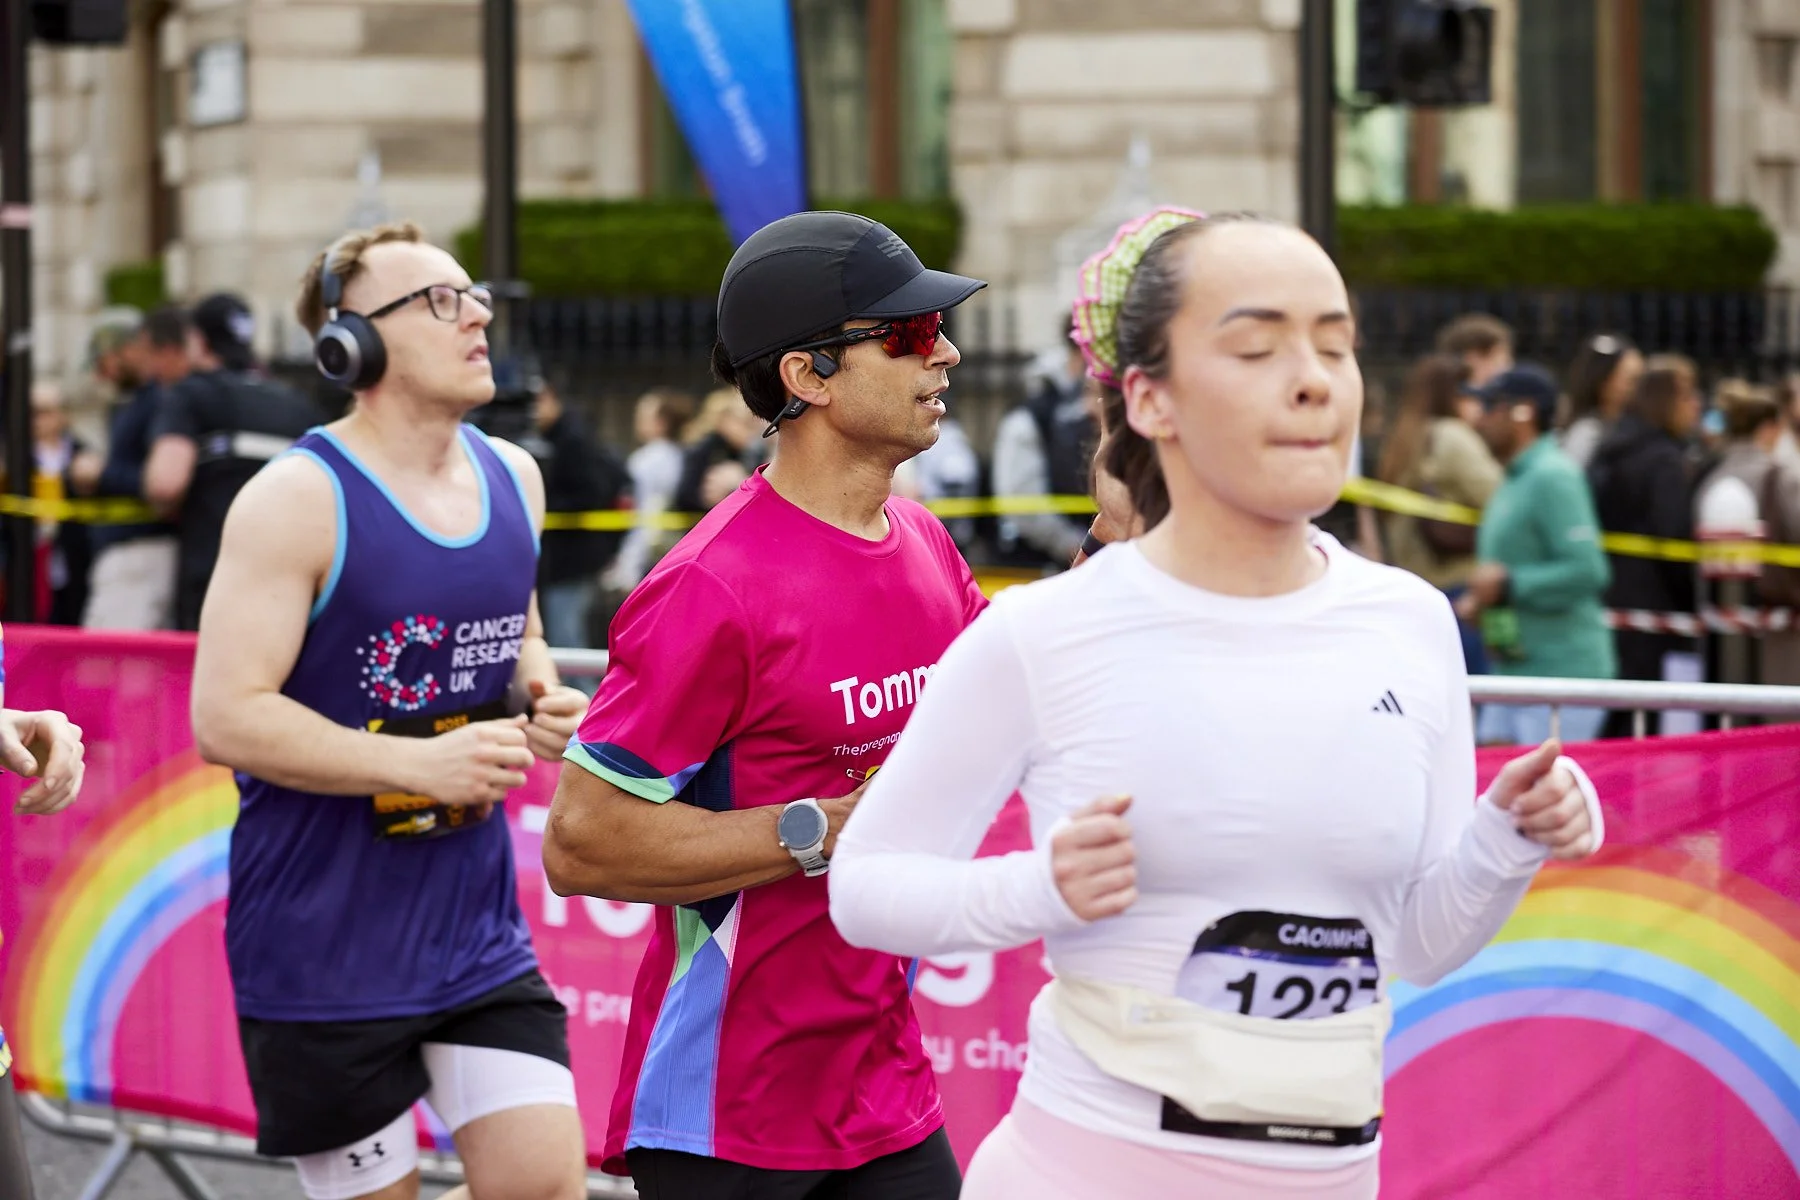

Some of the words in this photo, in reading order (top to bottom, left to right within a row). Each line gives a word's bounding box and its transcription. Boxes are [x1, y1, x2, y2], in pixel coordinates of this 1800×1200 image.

[455, 613, 526, 644] CANCER
[450, 669, 478, 693] UK
[833, 744, 860, 756] The
